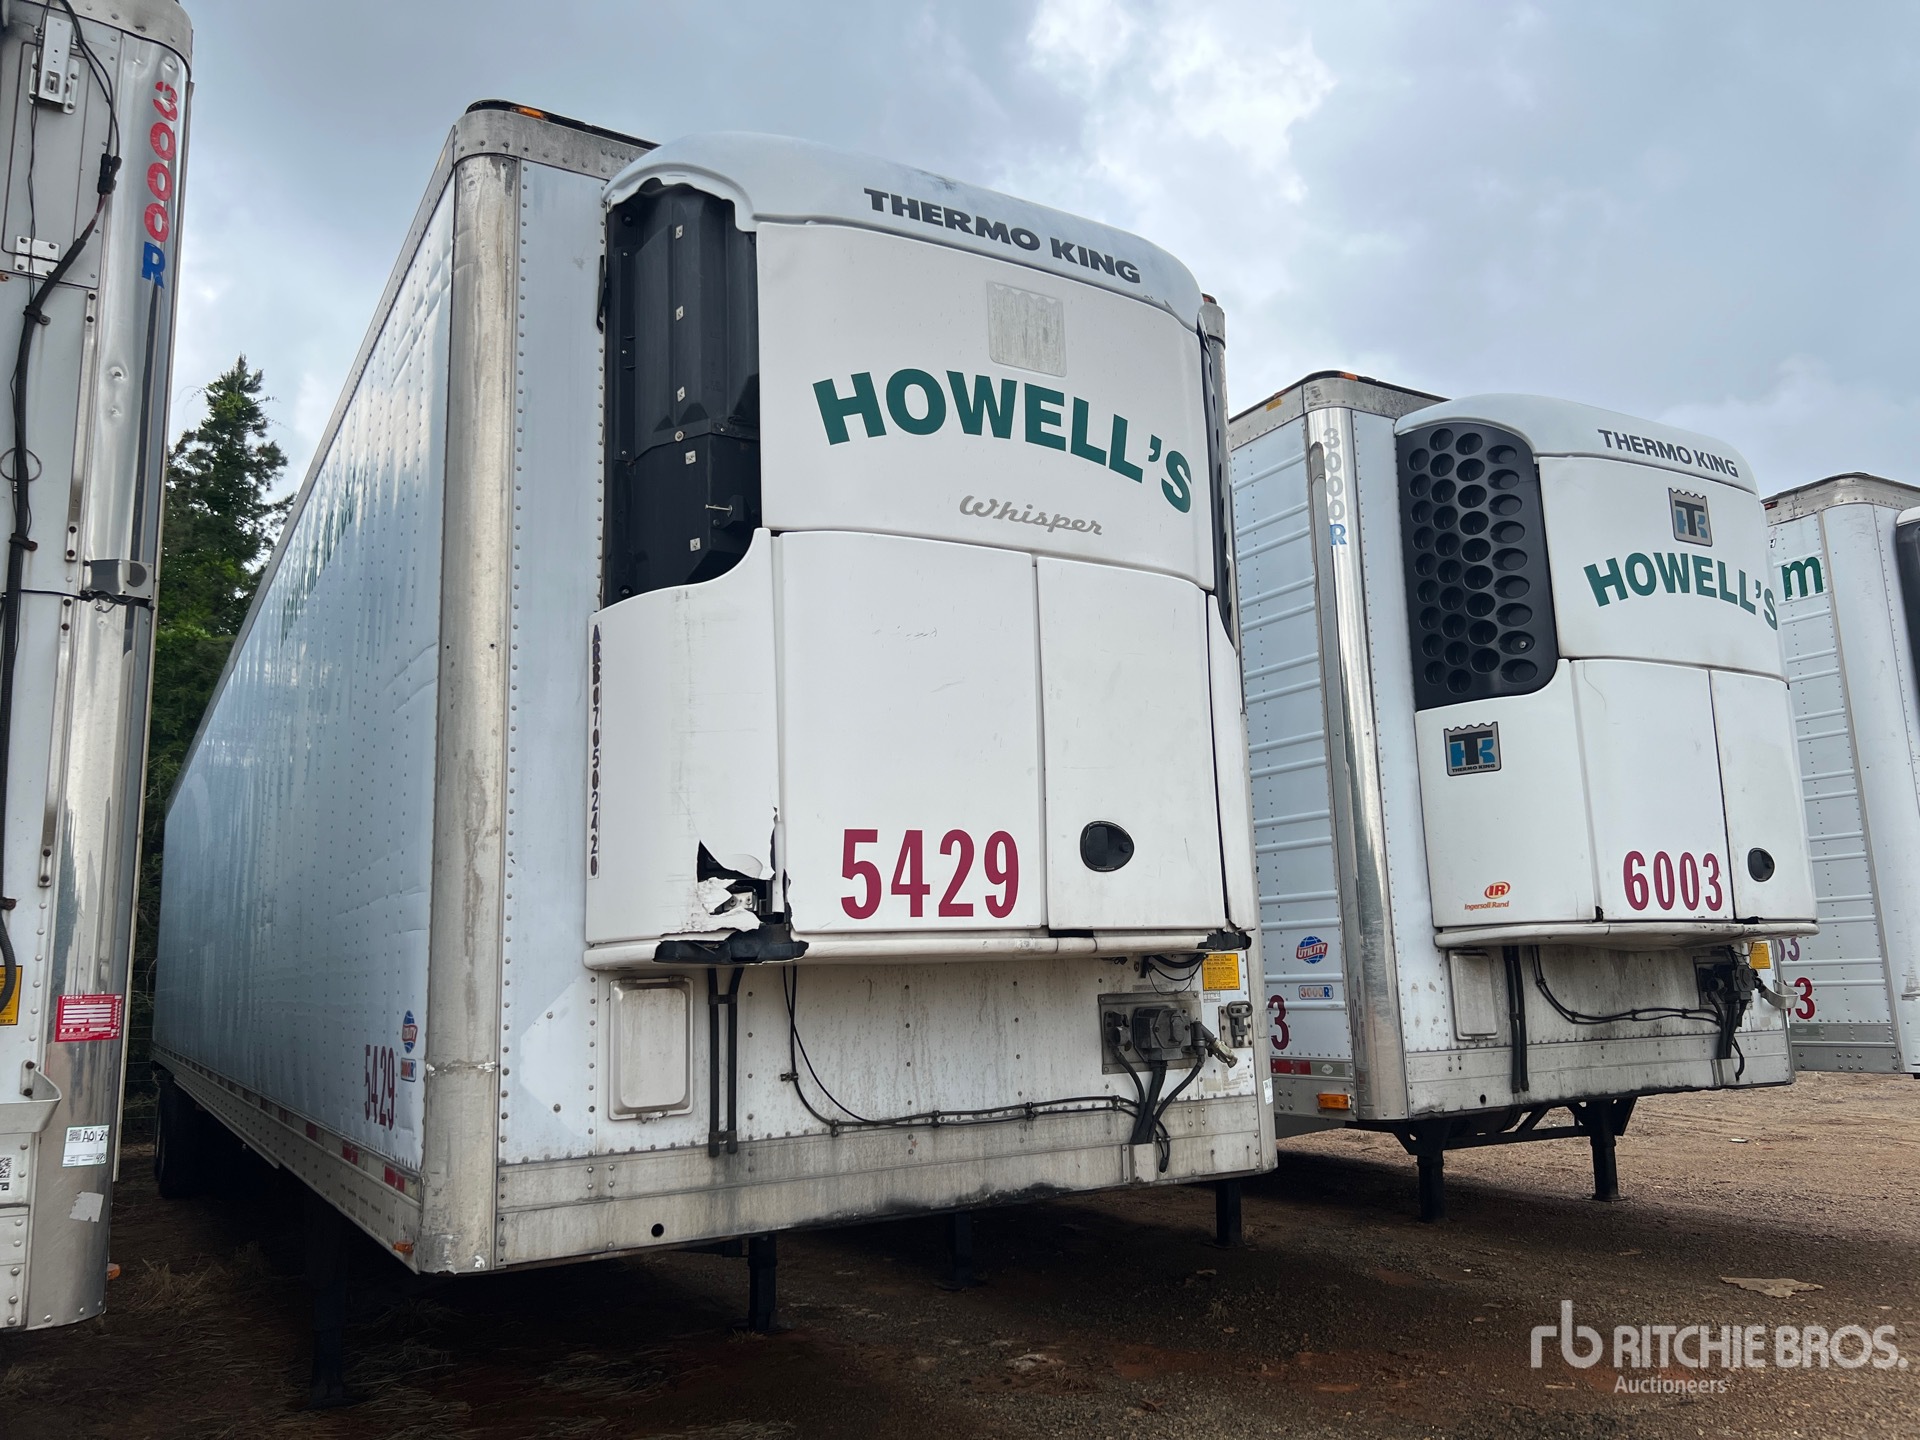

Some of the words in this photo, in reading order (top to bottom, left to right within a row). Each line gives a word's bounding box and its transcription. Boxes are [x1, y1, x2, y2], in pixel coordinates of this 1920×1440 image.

[863, 187, 1041, 252] THERMO
[1050, 236, 1141, 284] KING
[812, 367, 1192, 514] HOWELL'S
[1597, 428, 1692, 465] THERMO
[1693, 449, 1739, 478] KING
[959, 495, 1103, 536] Whisper
[1583, 552, 1778, 631] HOWELL'S
[1451, 765, 1478, 773] THERMO
[840, 828, 1019, 920] 5429
[1488, 884, 1506, 896] IR
[1623, 851, 1723, 912] 6003
[1464, 901, 1492, 911] Ingersoll
[1492, 900, 1510, 908] Rand
[1298, 943, 1327, 959] UTILITY
[364, 1044, 396, 1131] 5429
